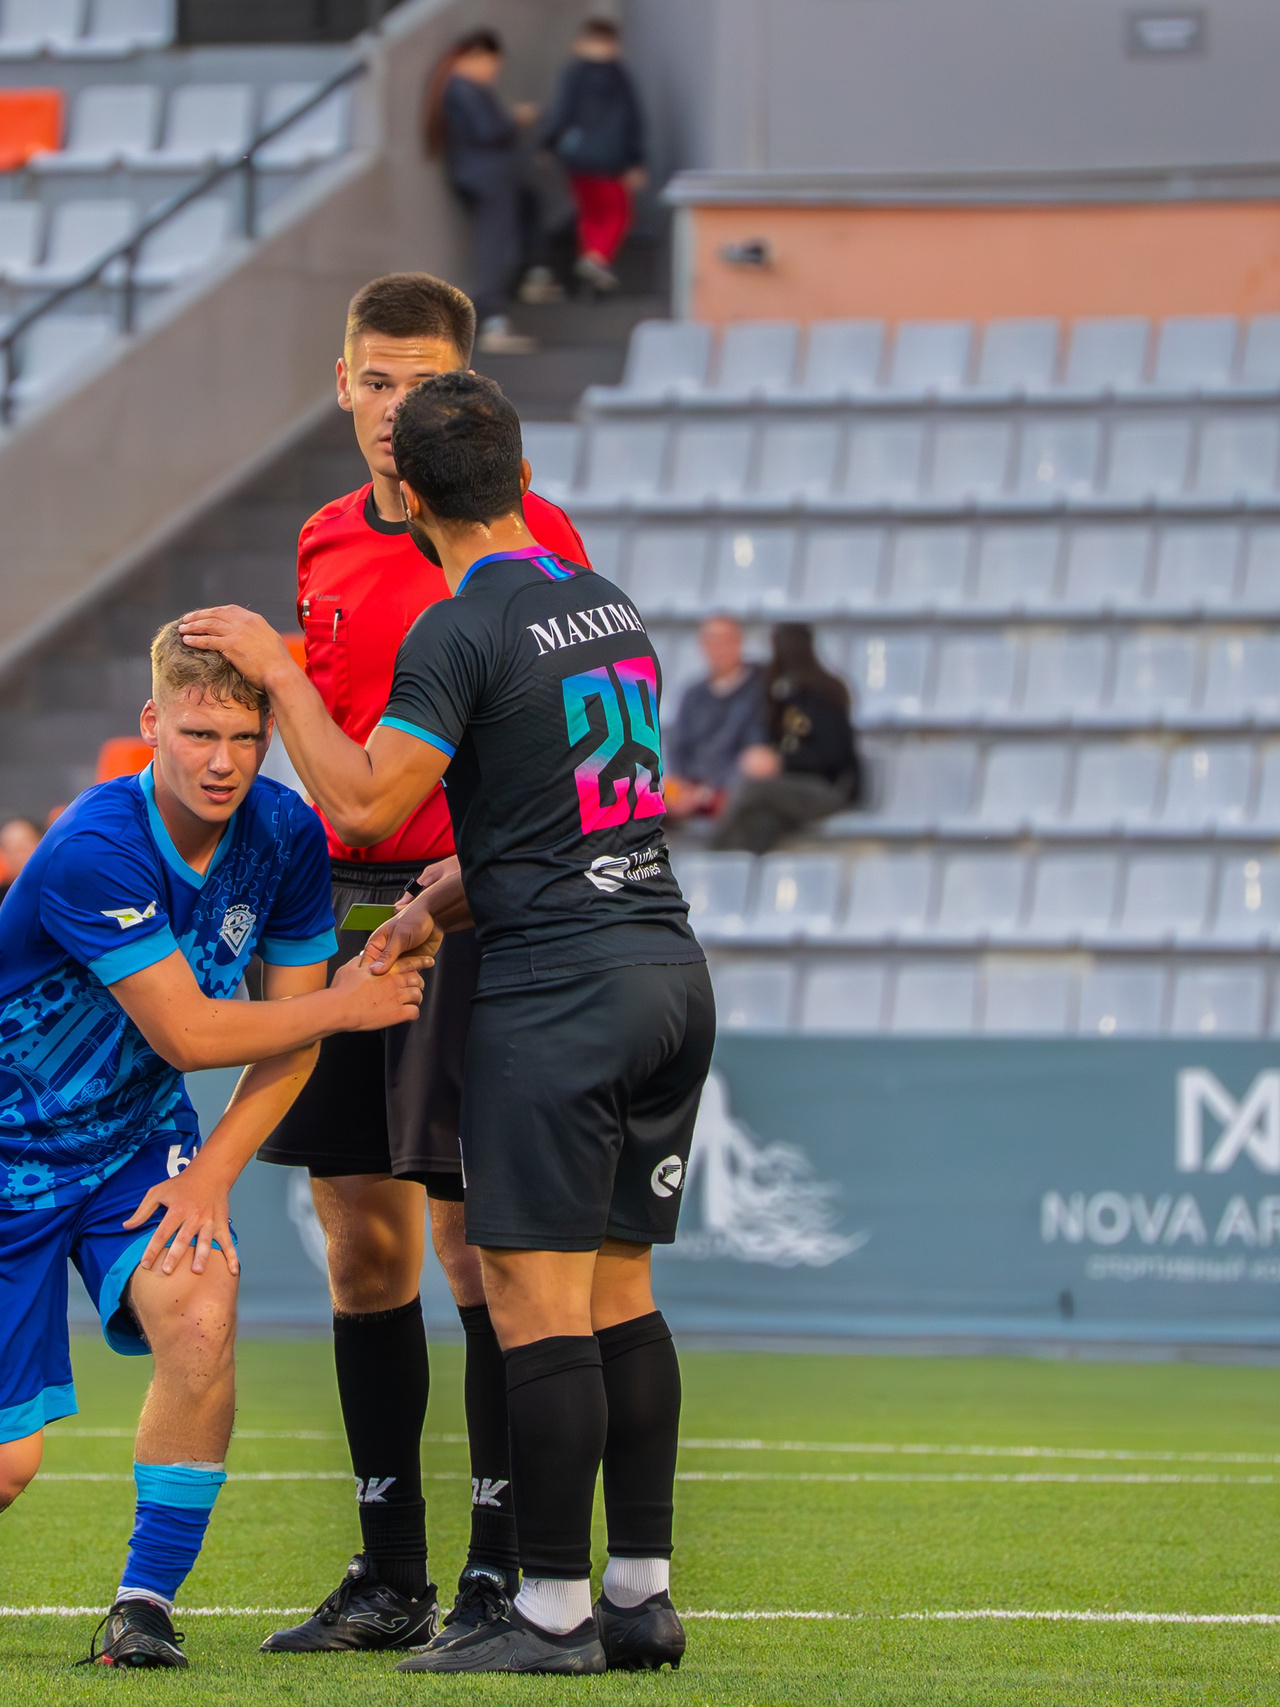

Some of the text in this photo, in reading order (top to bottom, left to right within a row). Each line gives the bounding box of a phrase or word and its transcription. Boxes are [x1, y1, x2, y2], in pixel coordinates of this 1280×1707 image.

[626, 862, 661, 881] Airlines
[166, 1144, 198, 1179] 6
[1041, 1190, 1207, 1245] NOVA
